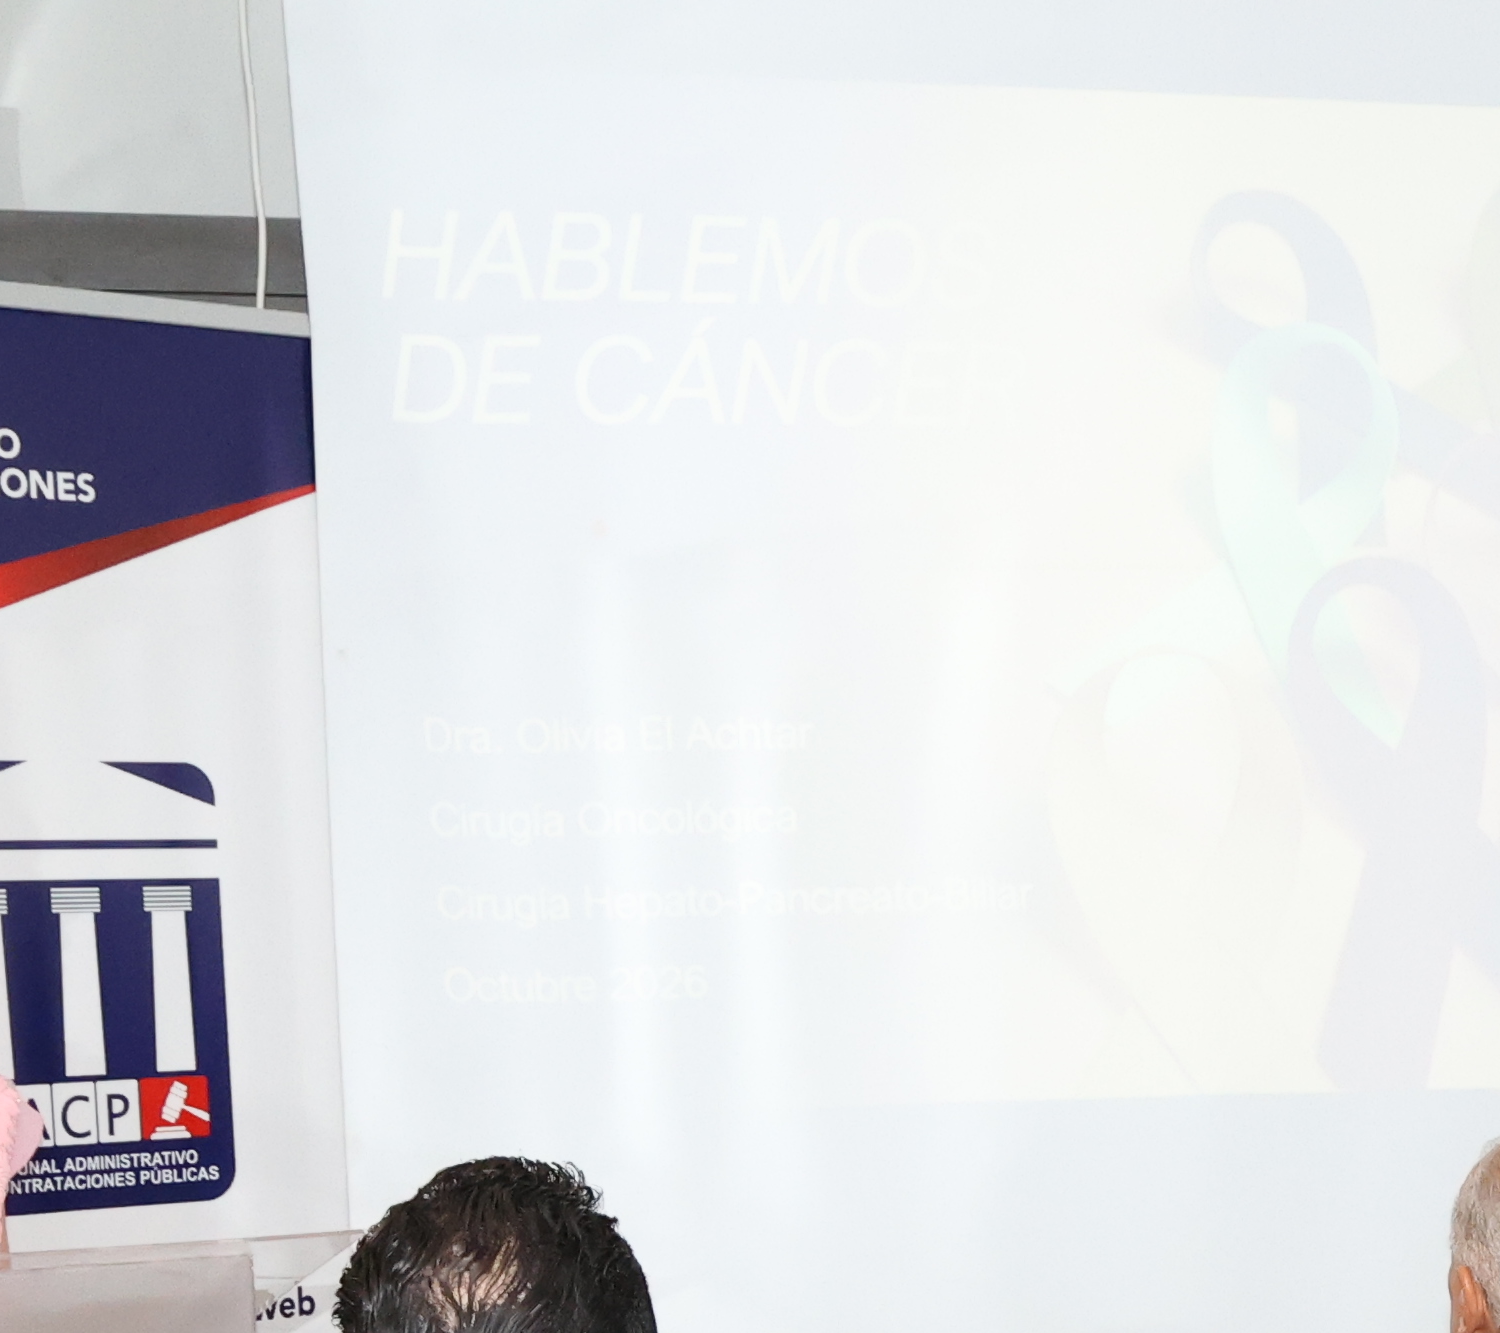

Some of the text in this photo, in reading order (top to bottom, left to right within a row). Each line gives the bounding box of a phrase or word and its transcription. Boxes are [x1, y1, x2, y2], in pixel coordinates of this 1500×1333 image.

[391, 331, 541, 426] DE
[16, 1149, 199, 1177] UNAL ADMINISTRATIVO
[140, 1164, 220, 1186] PÚBLICAS
